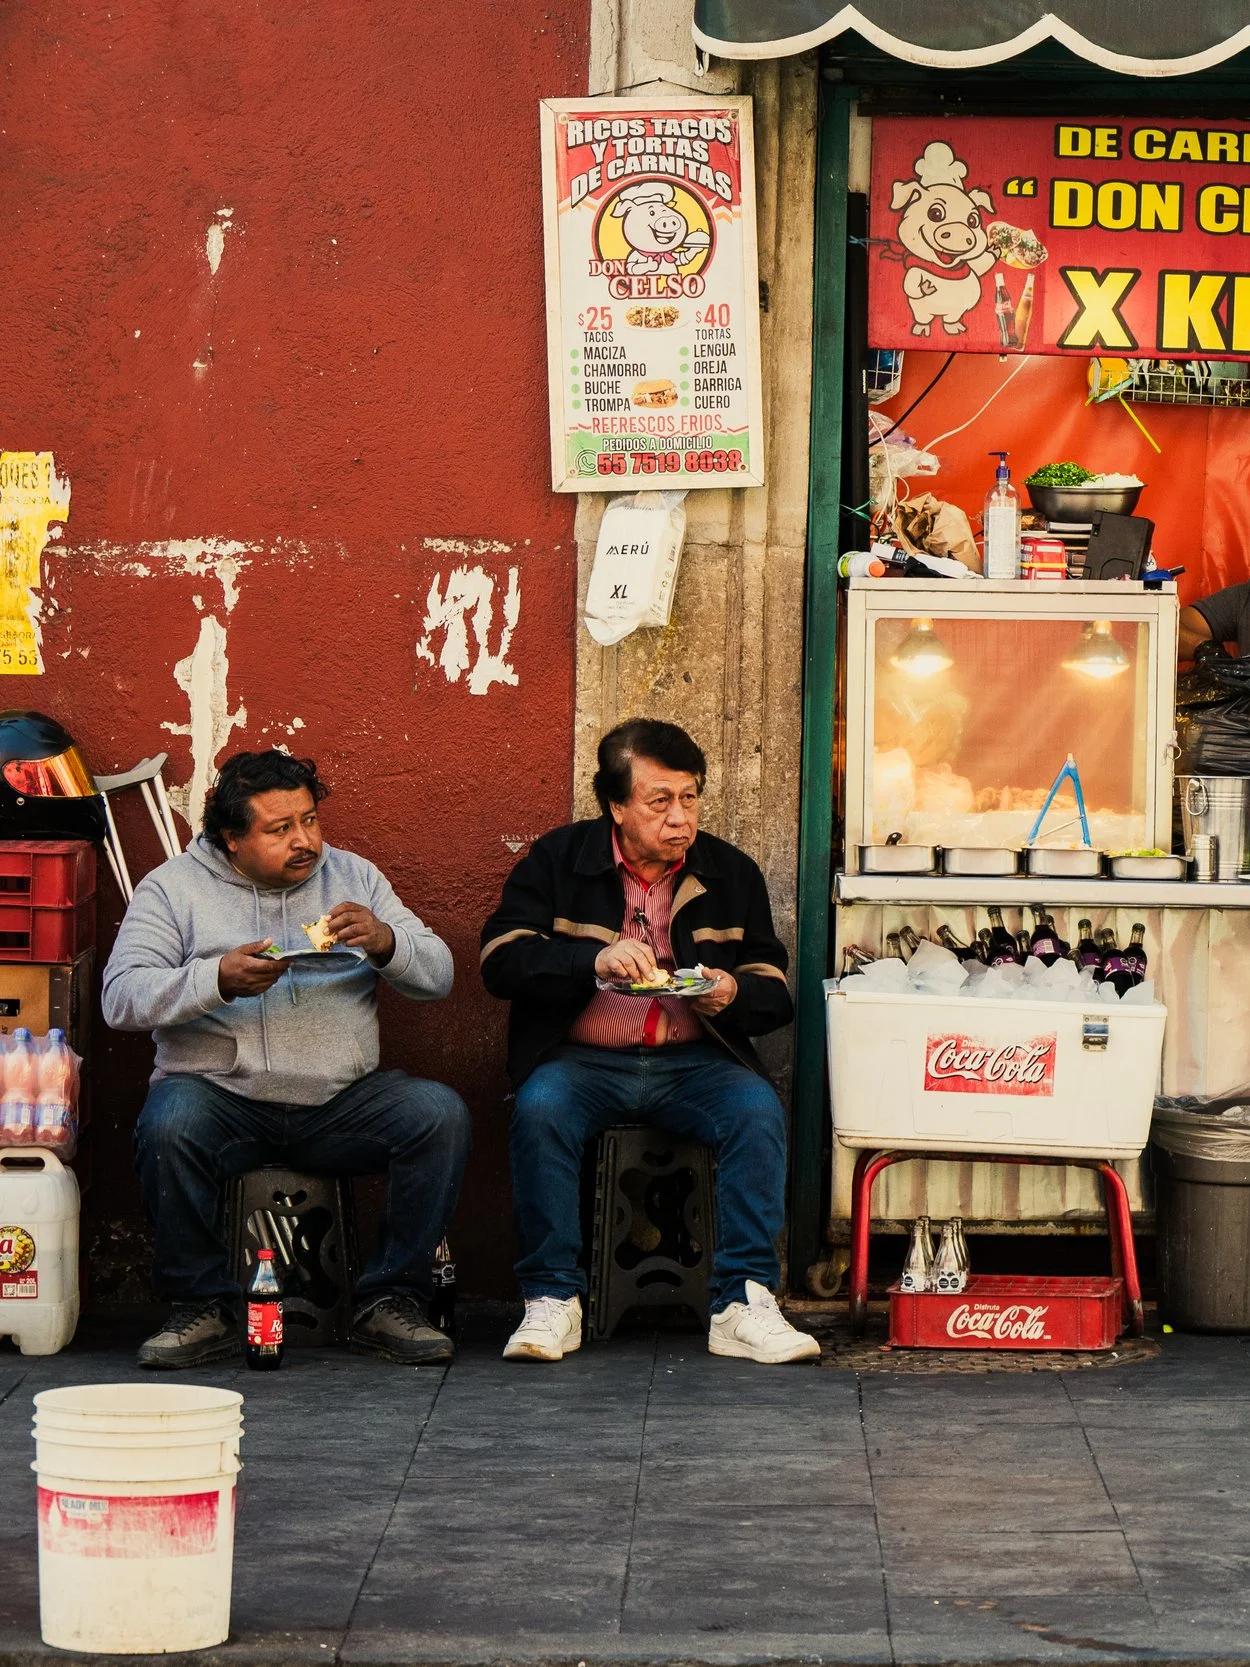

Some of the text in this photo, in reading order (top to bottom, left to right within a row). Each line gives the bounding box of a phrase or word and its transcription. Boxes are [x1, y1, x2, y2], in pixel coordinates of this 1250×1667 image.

[567, 117, 732, 148] RICOS TACOS
[591, 136, 709, 164] Y TORTAS
[1056, 125, 1119, 158] DE
[571, 154, 732, 208] DE CARNITAS
[1052, 180, 1181, 231] DON
[589, 258, 627, 277] DON
[608, 273, 706, 300] CELSO
[695, 303, 731, 328] $40
[1063, 268, 1140, 349] X
[578, 306, 613, 331] $25
[583, 331, 614, 343] TACOS
[695, 328, 732, 341] TORTAS
[583, 346, 627, 360] MACIZA
[693, 342, 736, 358] LENGUA
[584, 362, 647, 377] CHAMORRO
[694, 360, 728, 375] OREJA
[585, 380, 622, 395] BUCHE
[694, 377, 742, 392] BARRIGA
[586, 398, 631, 412] TROMPA
[695, 395, 731, 409] CUERO
[592, 414, 723, 434] REFRESCOS FRIOS
[602, 436, 713, 451] PEDIDOS A DOMICILIO
[597, 449, 742, 475] 55 7519 8038
[606, 541, 650, 555] MERÚ
[610, 584, 628, 599] XL
[927, 1039, 1052, 1084] Coca-Cola
[973, 1303, 1000, 1311] Disfruta
[946, 1304, 1049, 1340] Coca-Cola
